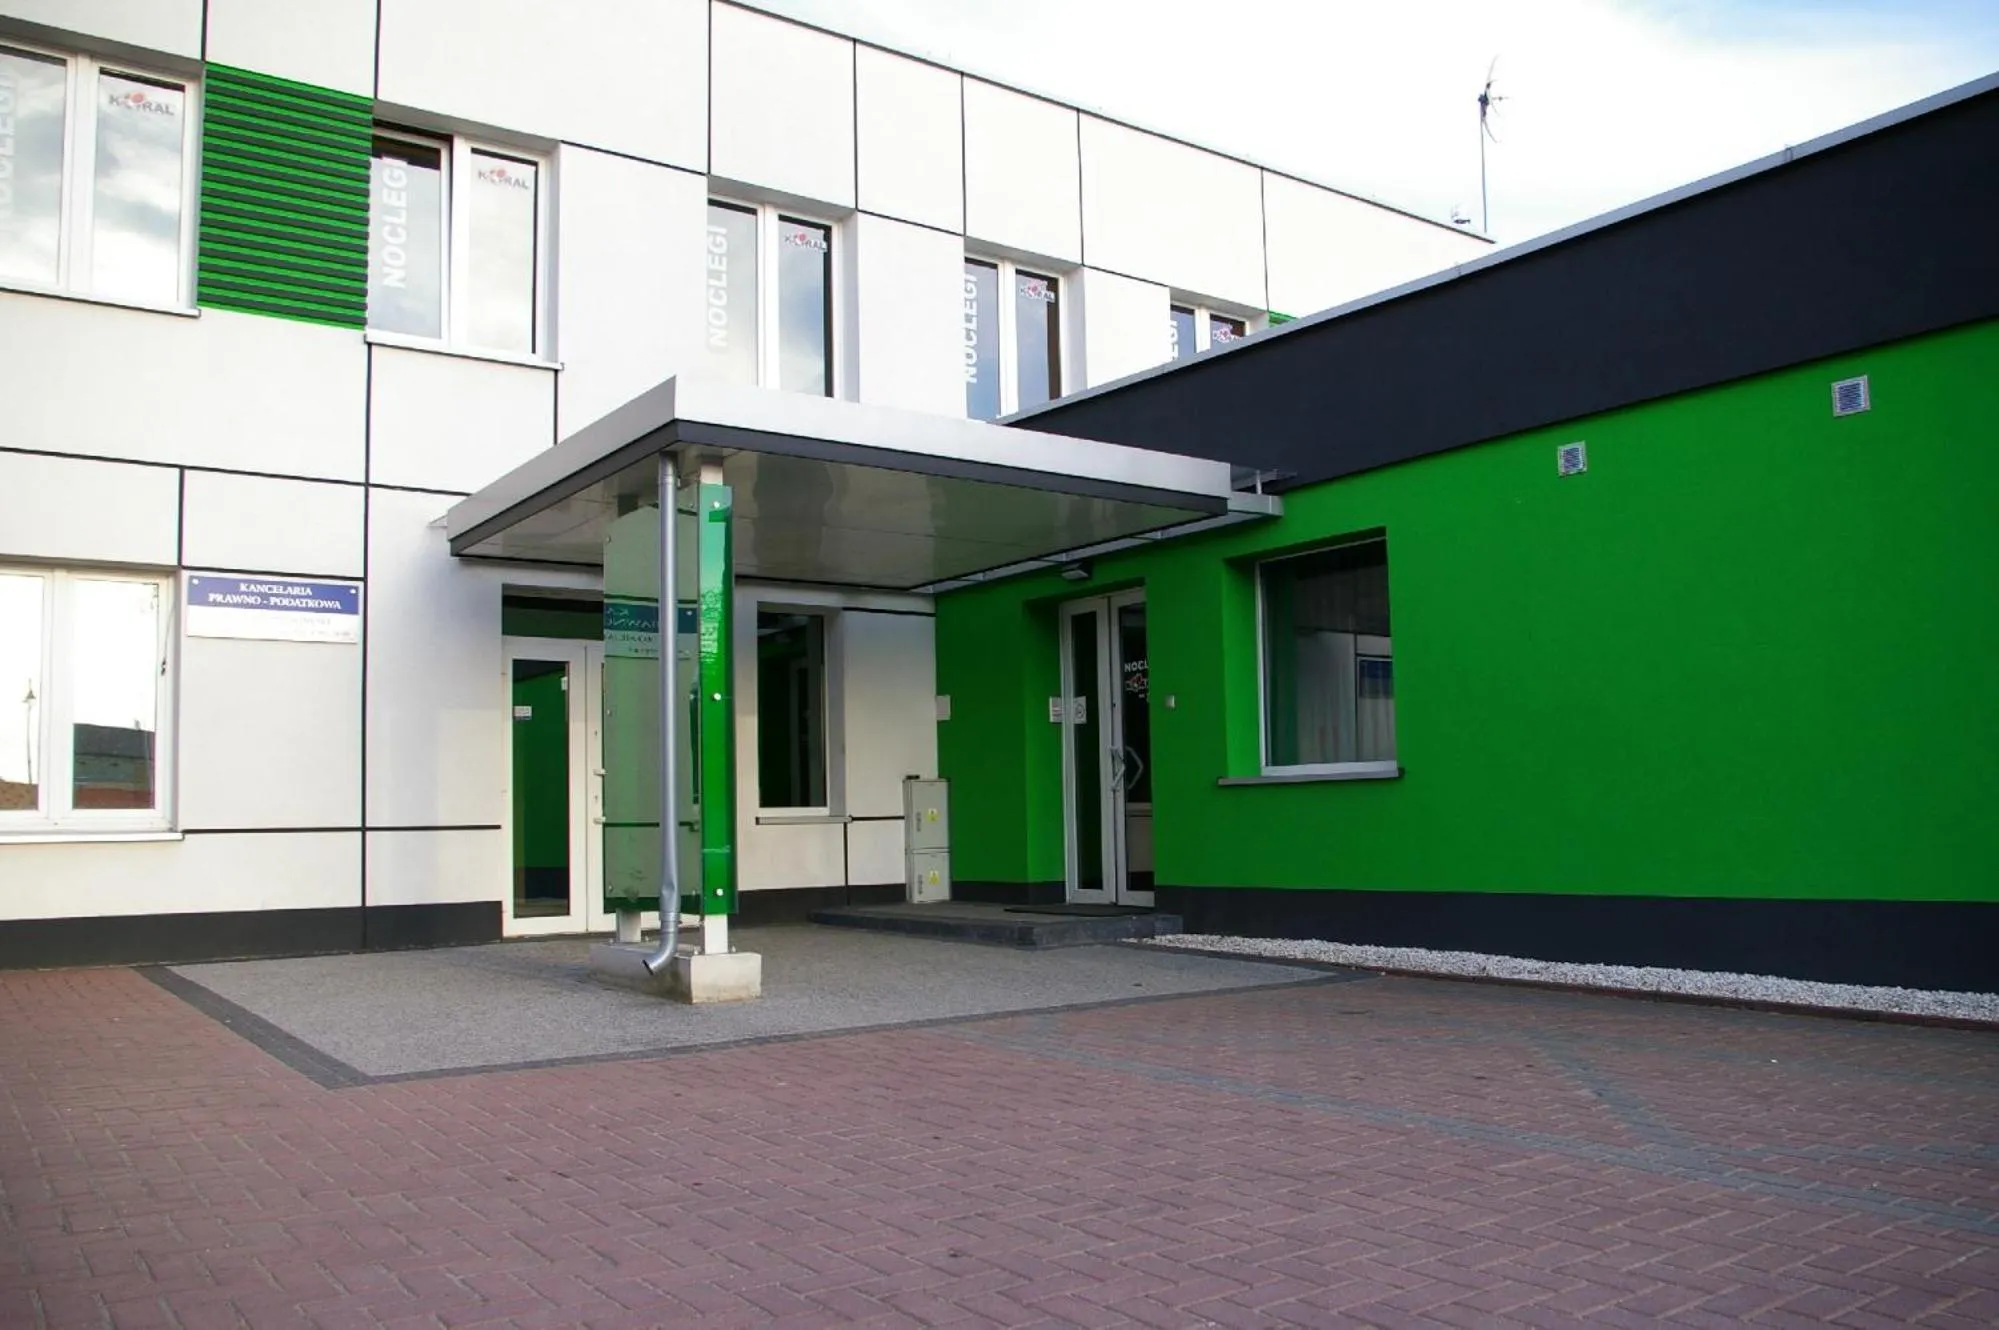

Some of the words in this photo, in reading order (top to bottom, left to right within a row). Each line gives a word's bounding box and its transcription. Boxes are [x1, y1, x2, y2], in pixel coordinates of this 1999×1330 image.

[382, 155, 408, 290] NOCLEGI
[707, 225, 728, 348] NOCLEGI
[208, 593, 261, 605] PRAWNO
[270, 596, 342, 610] PODATKOWA
[239, 583, 312, 596] KANCELARIA
